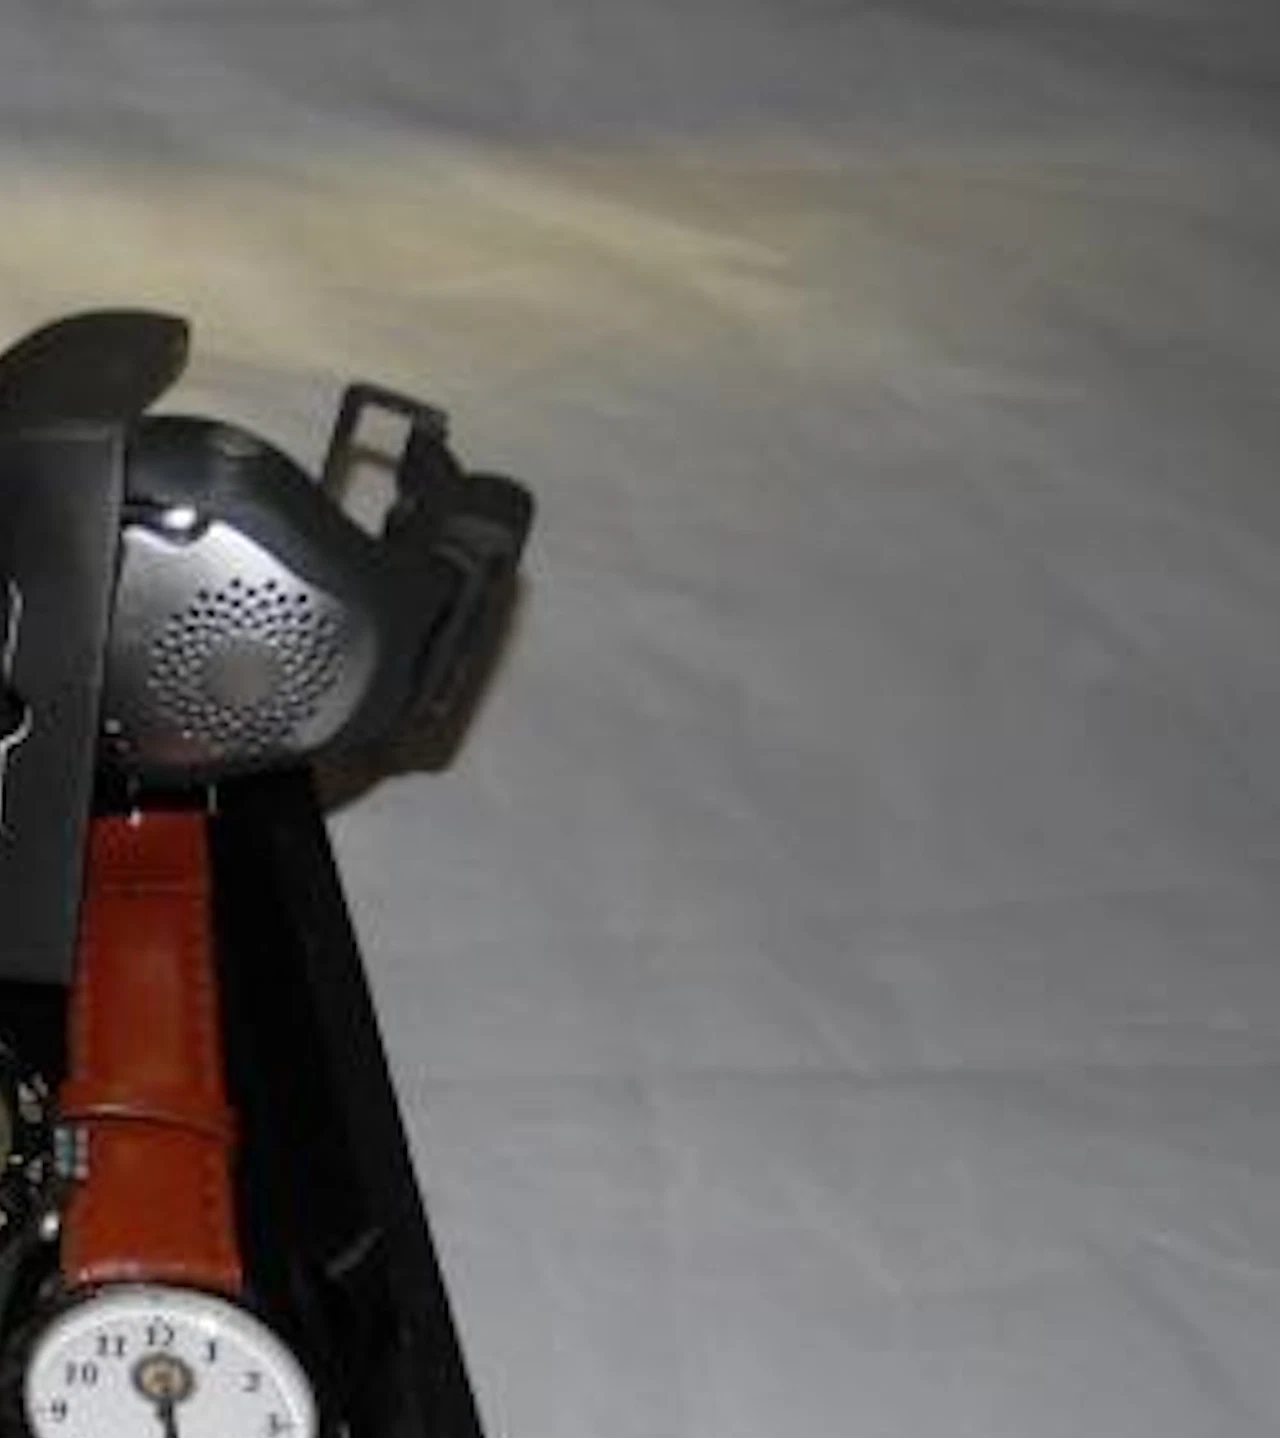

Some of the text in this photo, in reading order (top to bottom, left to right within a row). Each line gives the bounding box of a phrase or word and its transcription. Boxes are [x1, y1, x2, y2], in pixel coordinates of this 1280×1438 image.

[96, 1334, 126, 1358] 11
[146, 1322, 175, 1347] 12
[65, 1361, 99, 1386] 10
